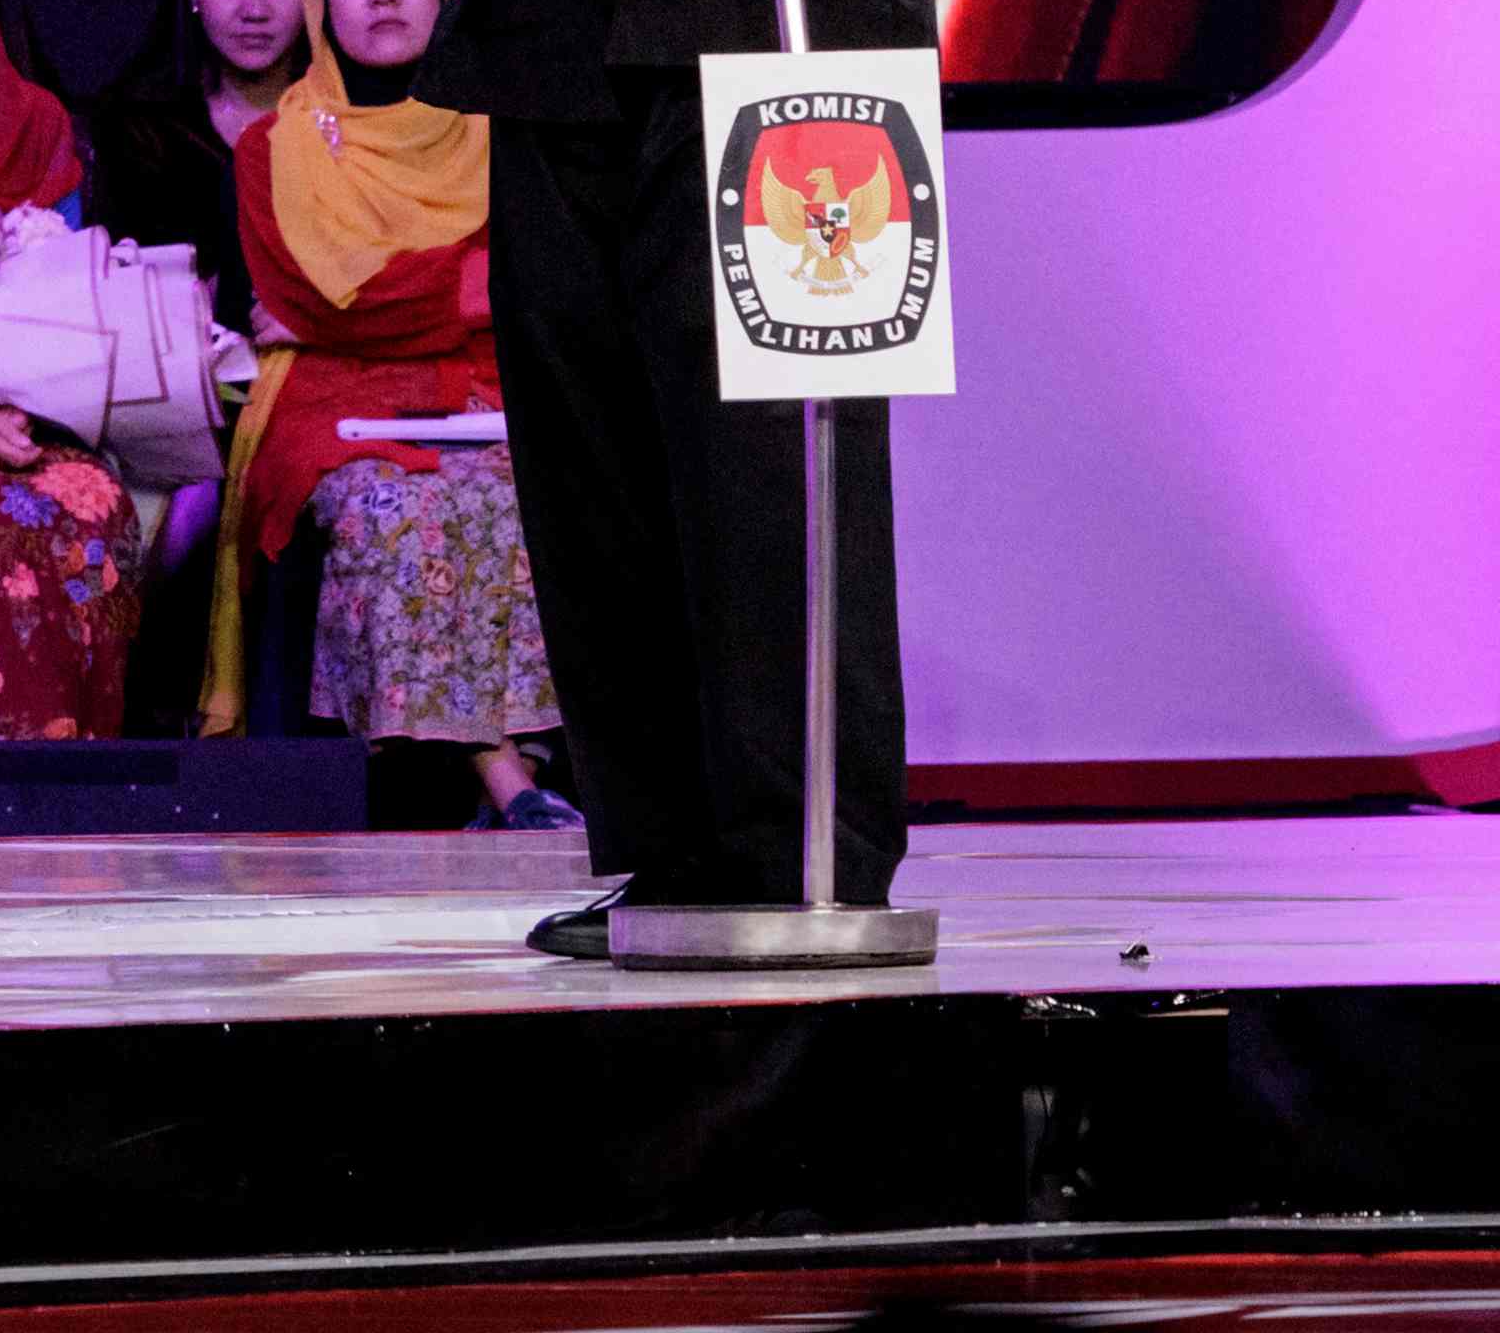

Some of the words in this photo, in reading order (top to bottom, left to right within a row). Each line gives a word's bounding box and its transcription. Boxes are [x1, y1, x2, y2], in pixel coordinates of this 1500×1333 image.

[759, 95, 887, 125] KOMISI
[722, 242, 875, 351] PEMILIHAN
[882, 237, 936, 343] UMUM
